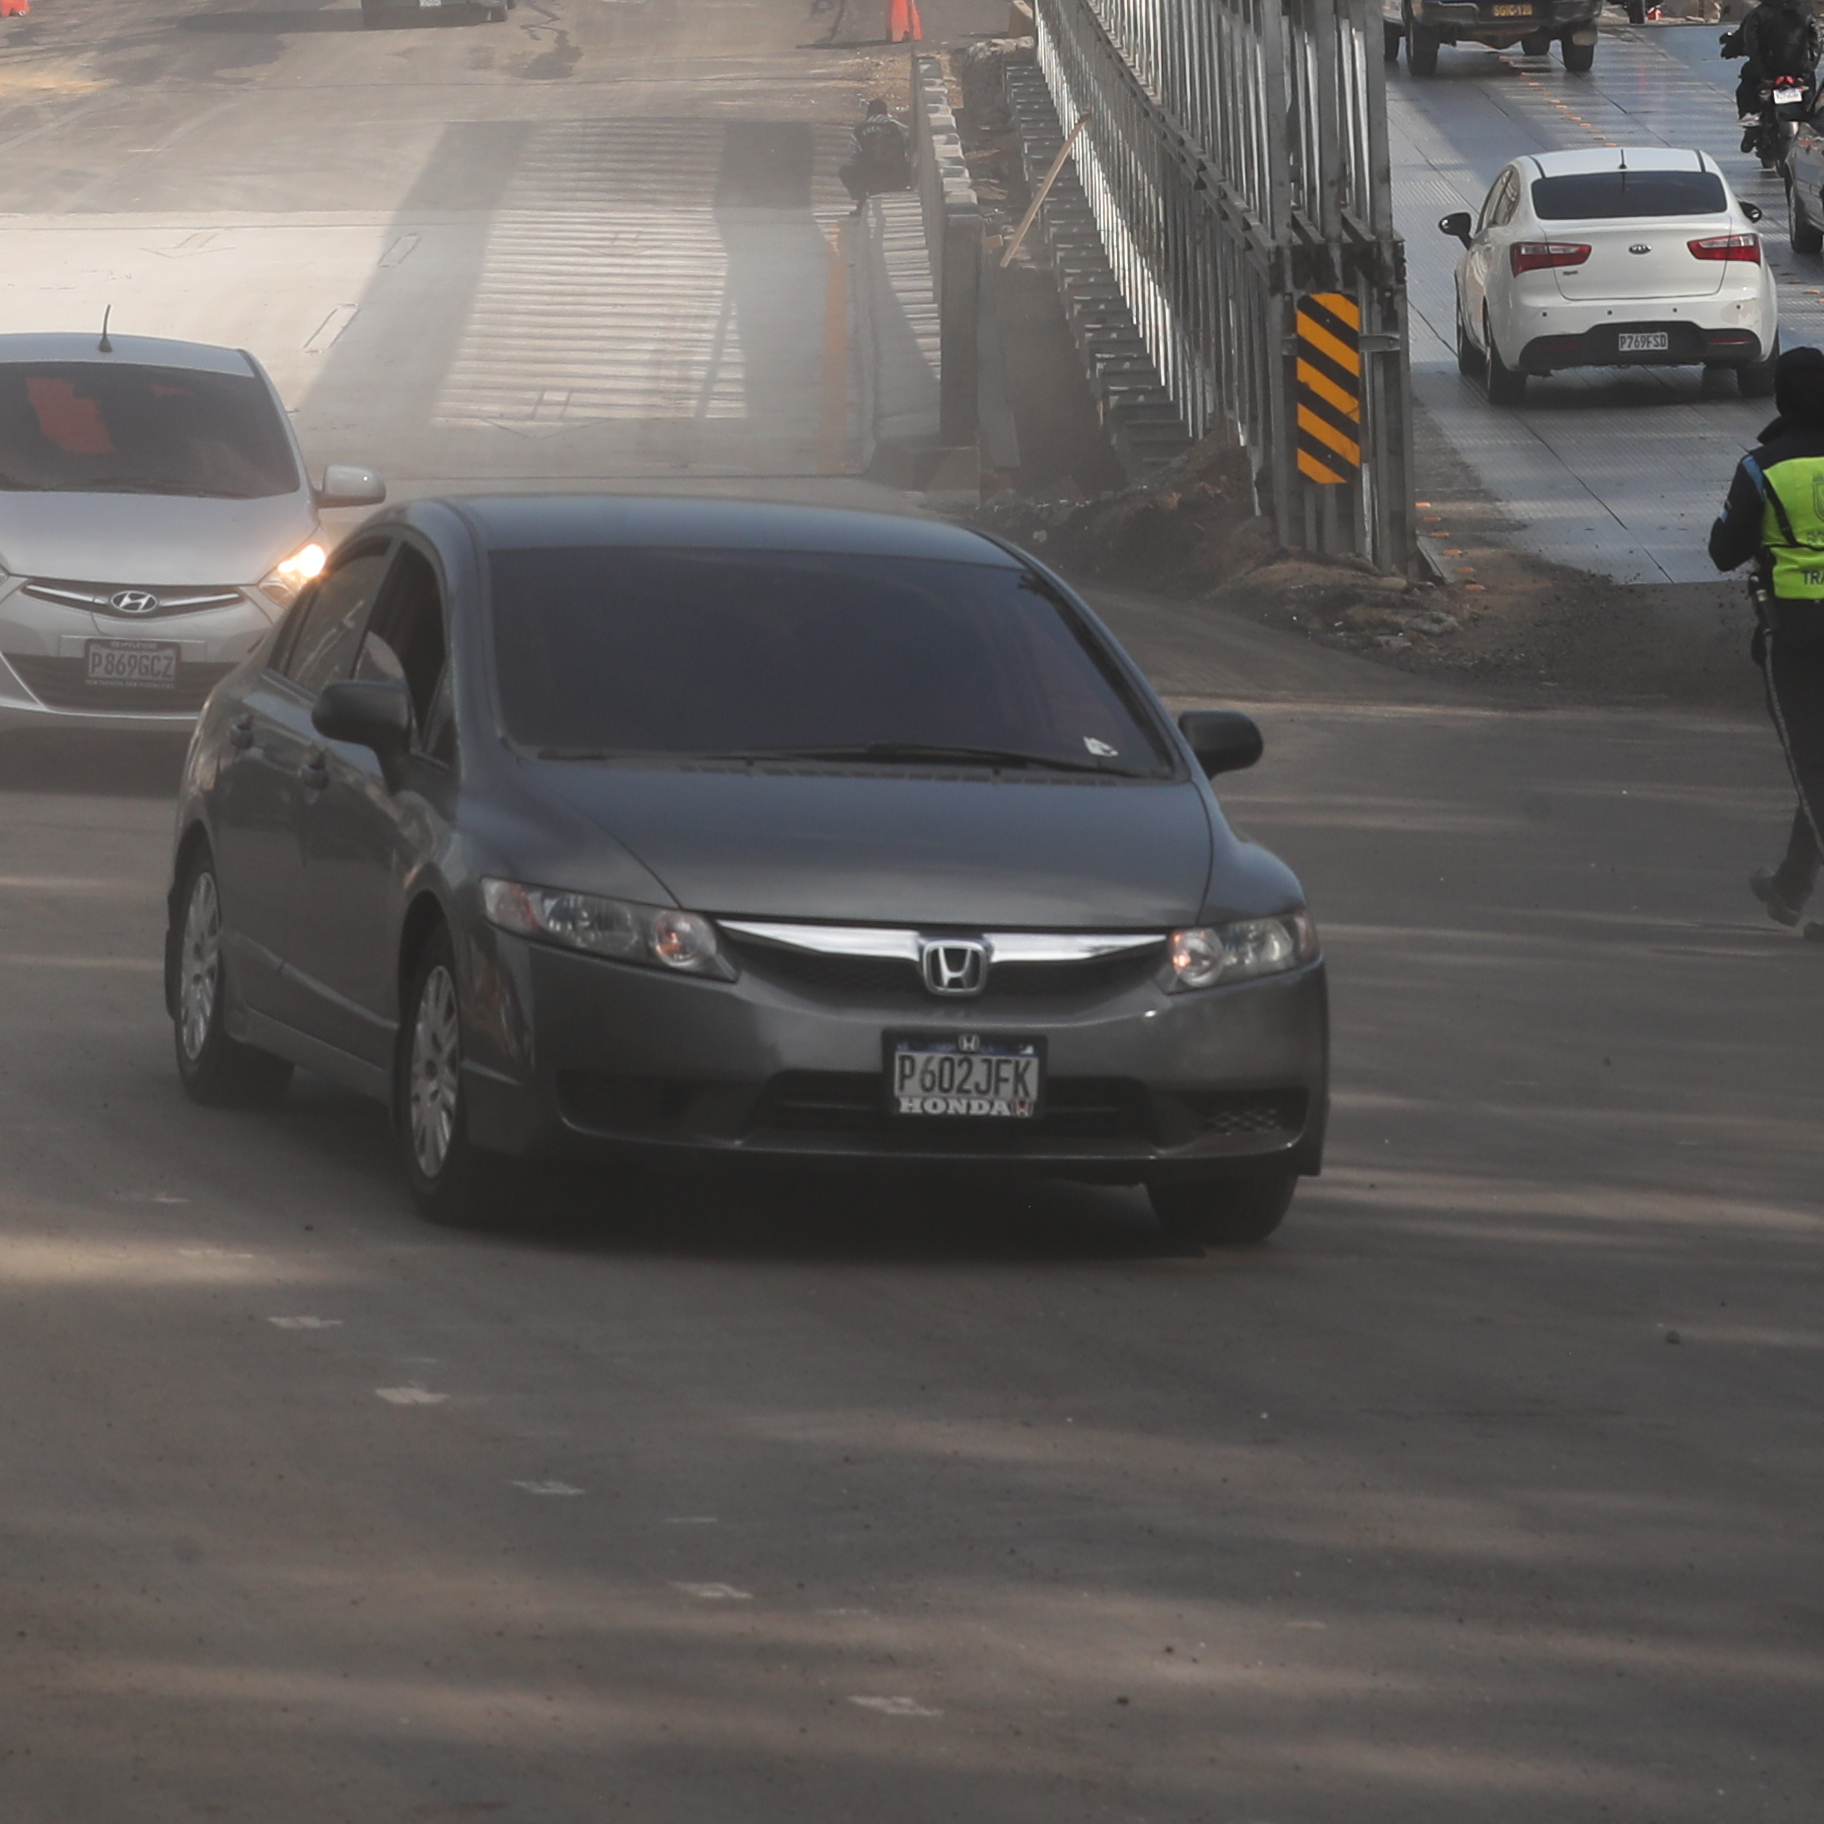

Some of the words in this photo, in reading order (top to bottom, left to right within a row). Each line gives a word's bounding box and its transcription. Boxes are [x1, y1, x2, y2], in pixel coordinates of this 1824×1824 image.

[1493, 4, 1533, 16] SGIC-120
[1619, 334, 1667, 349] P769FSD
[90, 651, 175, 678] P869GCZ
[898, 1097, 1011, 1117] HONDA
